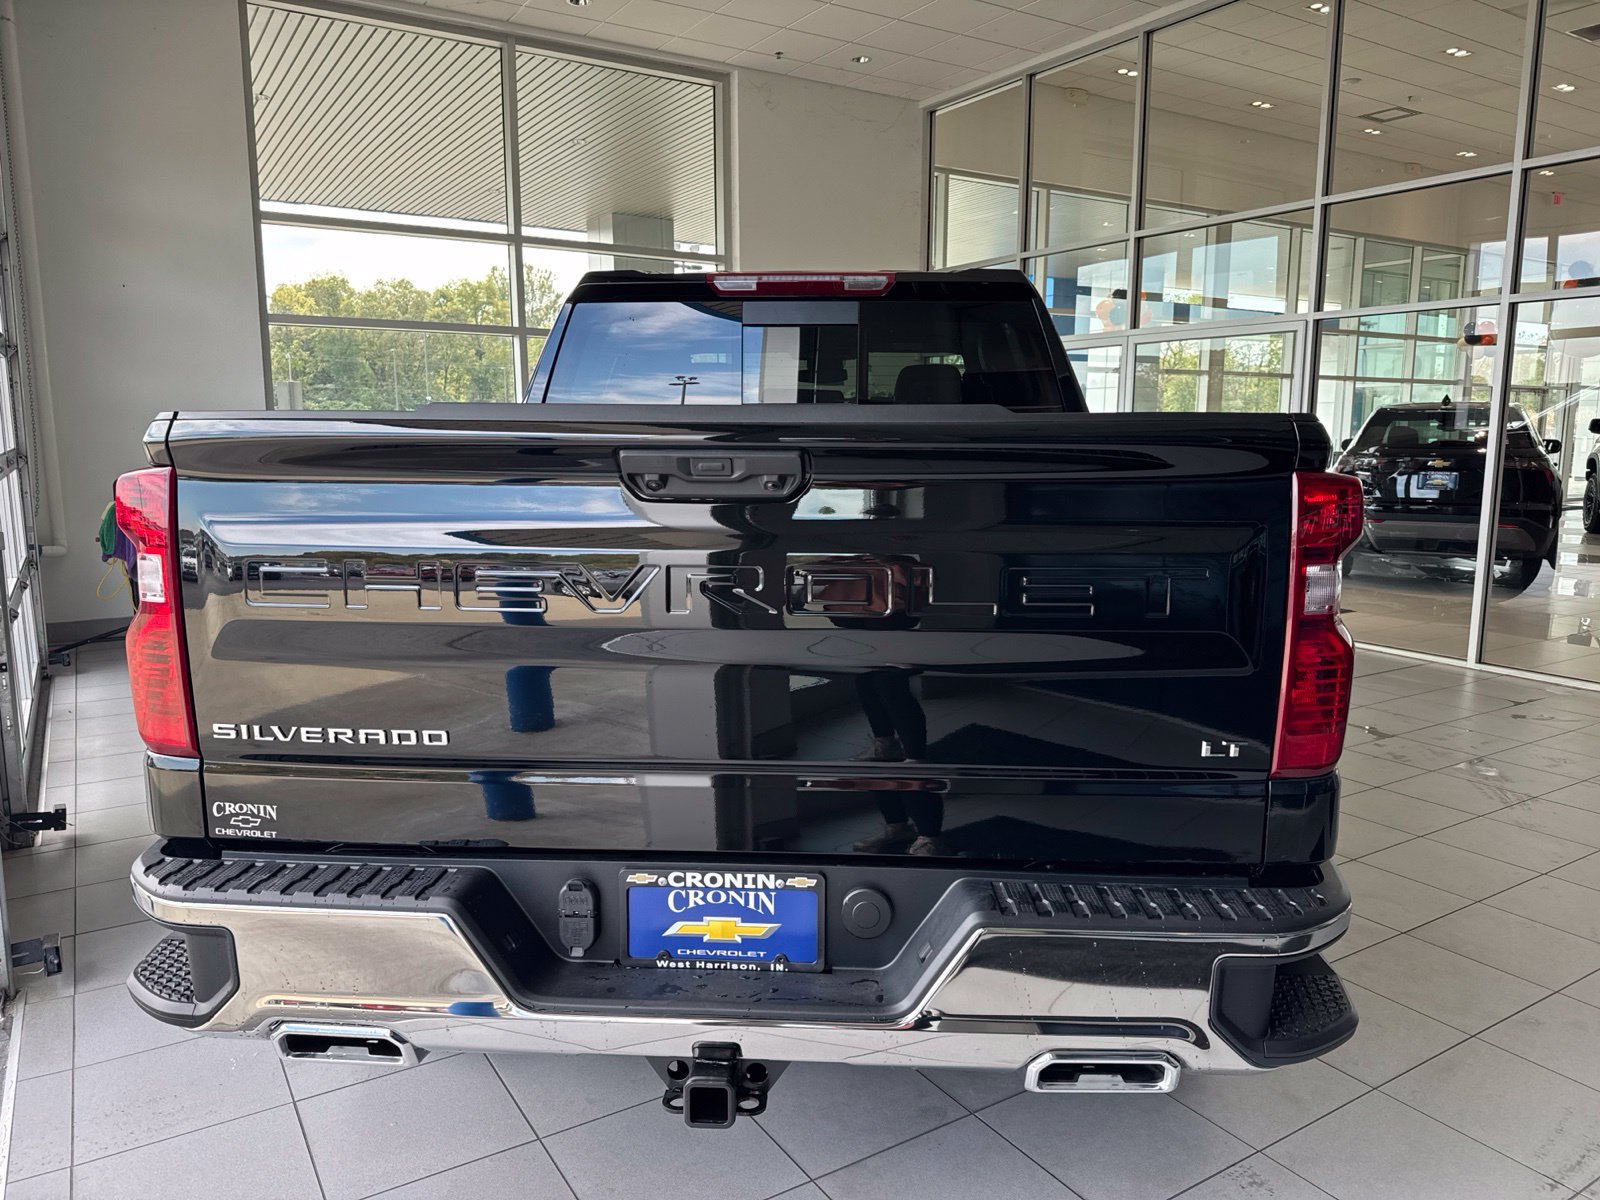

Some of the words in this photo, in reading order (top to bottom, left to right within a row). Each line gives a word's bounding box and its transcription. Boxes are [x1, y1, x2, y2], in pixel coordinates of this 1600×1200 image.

[245, 558, 1211, 620] CHEVROLET
[212, 723, 450, 746] SILVERADO
[1201, 740, 1249, 758] LT
[212, 801, 278, 821] CRONIN
[215, 827, 277, 839] CHEVROLET
[667, 871, 776, 890] CRONIN
[667, 889, 777, 916] CRONIN
[677, 949, 767, 958] CHEVROLET
[656, 960, 691, 969] West
[696, 961, 761, 972] Harrison,
[770, 963, 789, 972] IN.
